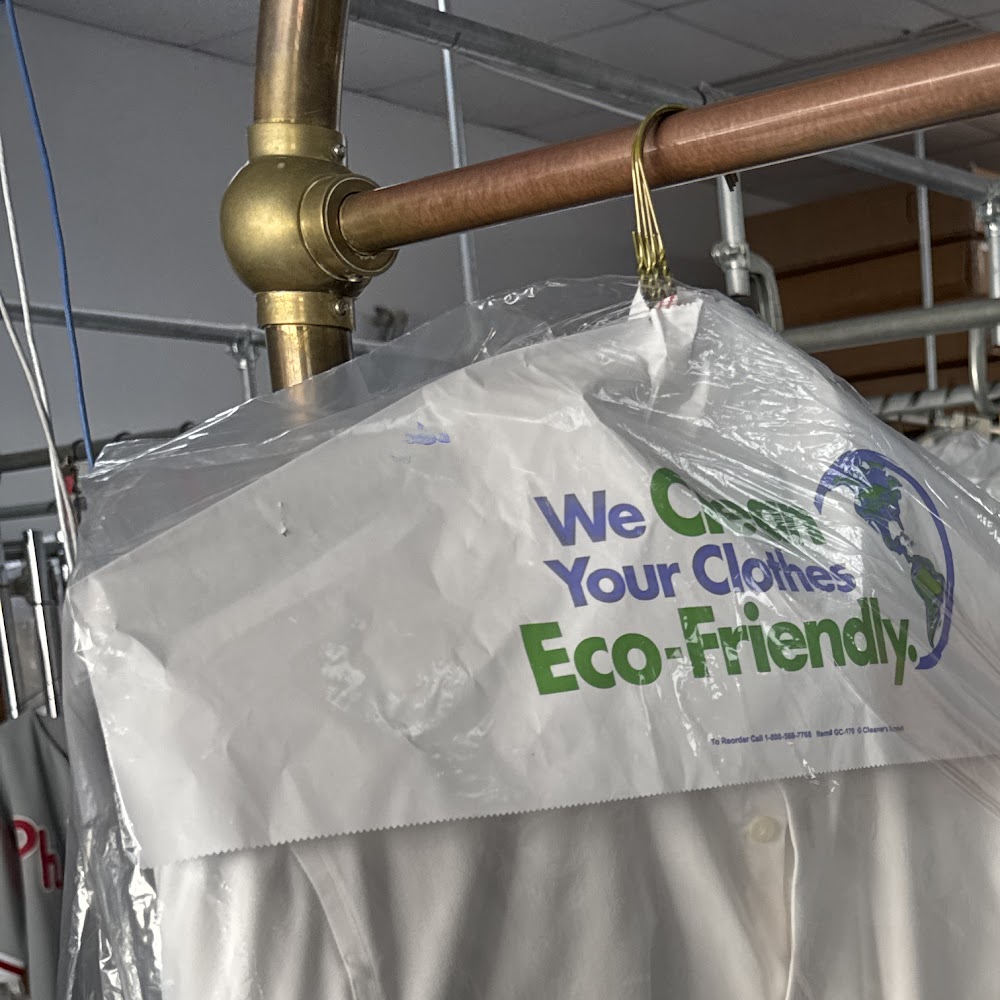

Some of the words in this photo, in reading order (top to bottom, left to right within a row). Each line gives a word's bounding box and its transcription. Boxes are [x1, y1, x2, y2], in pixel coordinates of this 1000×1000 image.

[534, 490, 646, 547] We
[543, 556, 681, 607] Your
[692, 543, 857, 597] Clothes
[519, 598, 917, 696] Eco-Friendly.
[711, 737, 720, 745] To
[721, 735, 749, 745] Reorder
[750, 734, 764, 743] Call
[12, 818, 64, 890] Ph
